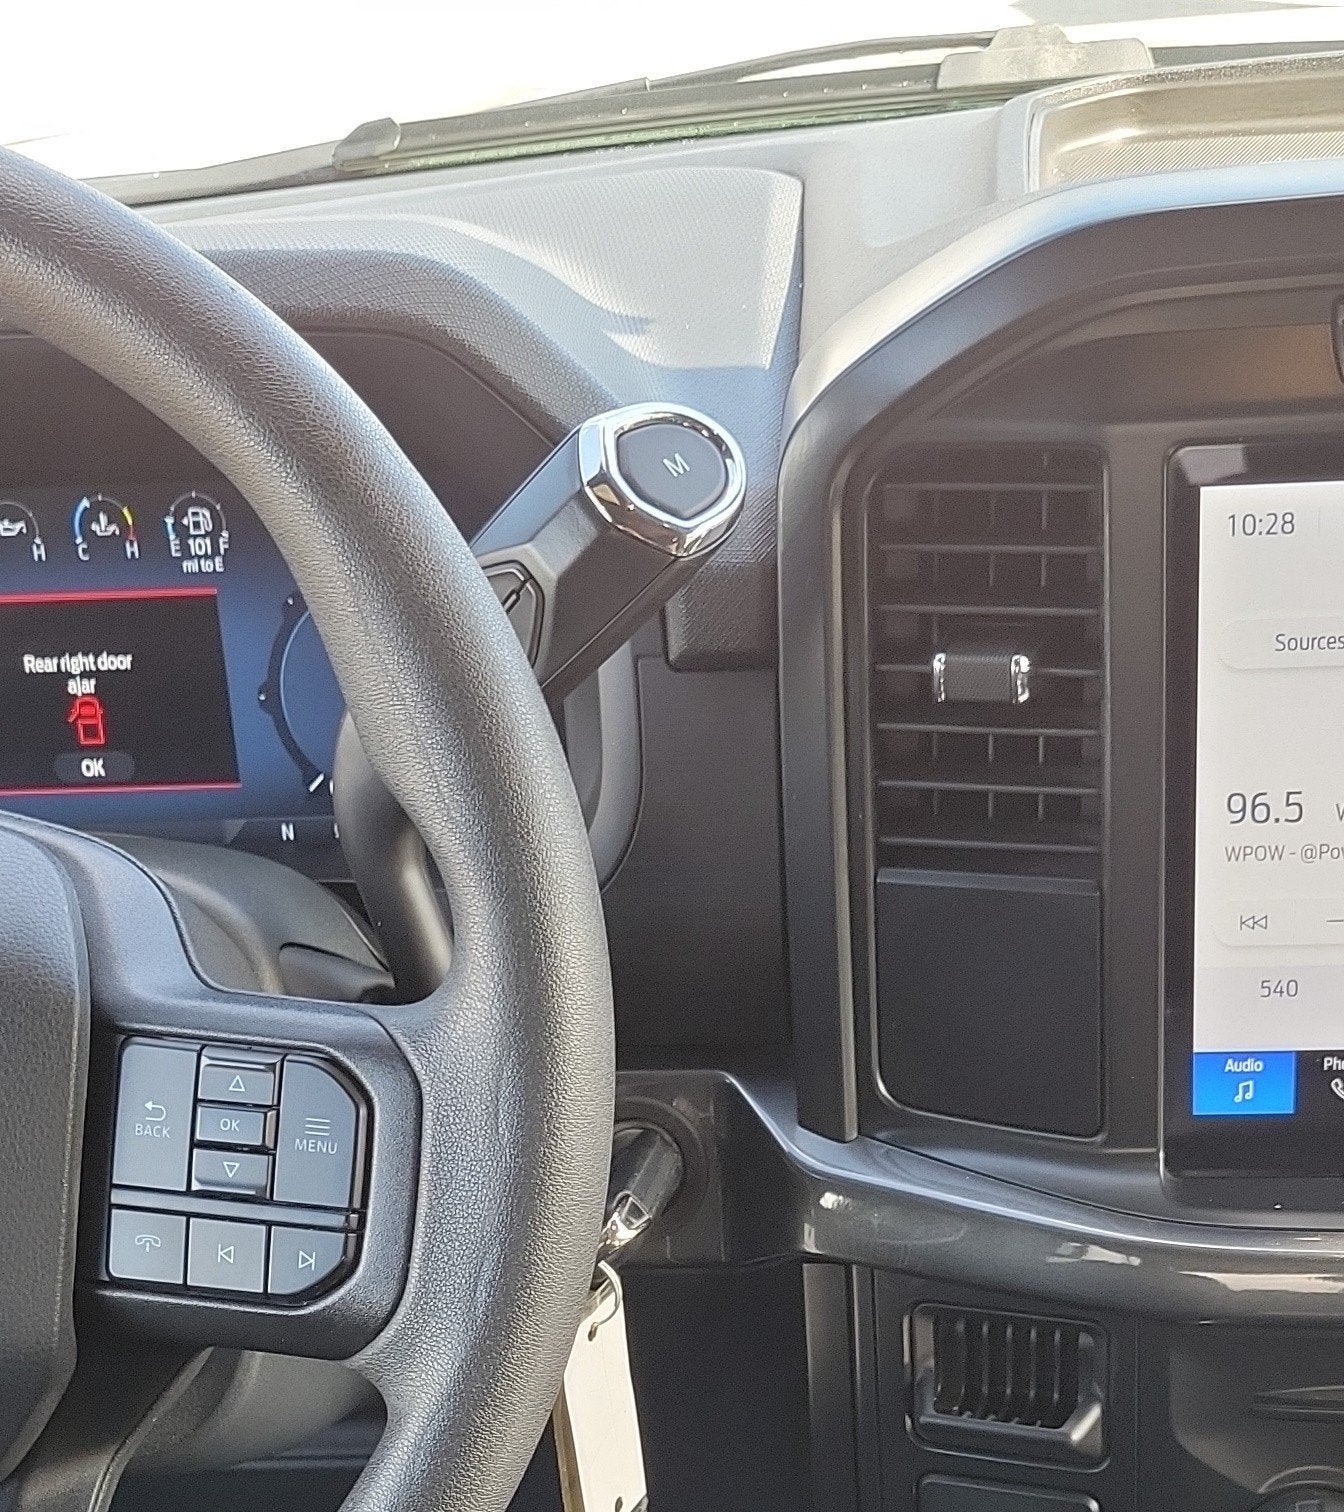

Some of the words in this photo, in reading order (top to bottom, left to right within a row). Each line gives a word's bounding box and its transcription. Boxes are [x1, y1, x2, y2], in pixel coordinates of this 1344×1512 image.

[662, 452, 690, 477] M
[1228, 511, 1295, 537] 10:28
[32, 542, 47, 562] H
[77, 542, 90, 561] C
[125, 539, 140, 559] H
[170, 538, 182, 557] E
[187, 538, 212, 556] 101
[219, 537, 231, 555] F
[200, 557, 213, 573] to
[215, 557, 225, 572] E
[22, 653, 59, 674] Rear
[59, 651, 96, 675] right
[97, 650, 133, 671] door
[67, 675, 96, 697] ajar
[80, 757, 106, 778] OK
[1226, 790, 1304, 825] 96.5
[280, 822, 295, 842] N
[1224, 844, 1285, 862] WPOW
[1260, 979, 1299, 998] 540
[1224, 1058, 1264, 1072] Audio
[135, 1123, 171, 1138] BACK
[219, 1118, 240, 1132] OK
[294, 1138, 338, 1155] MENU
